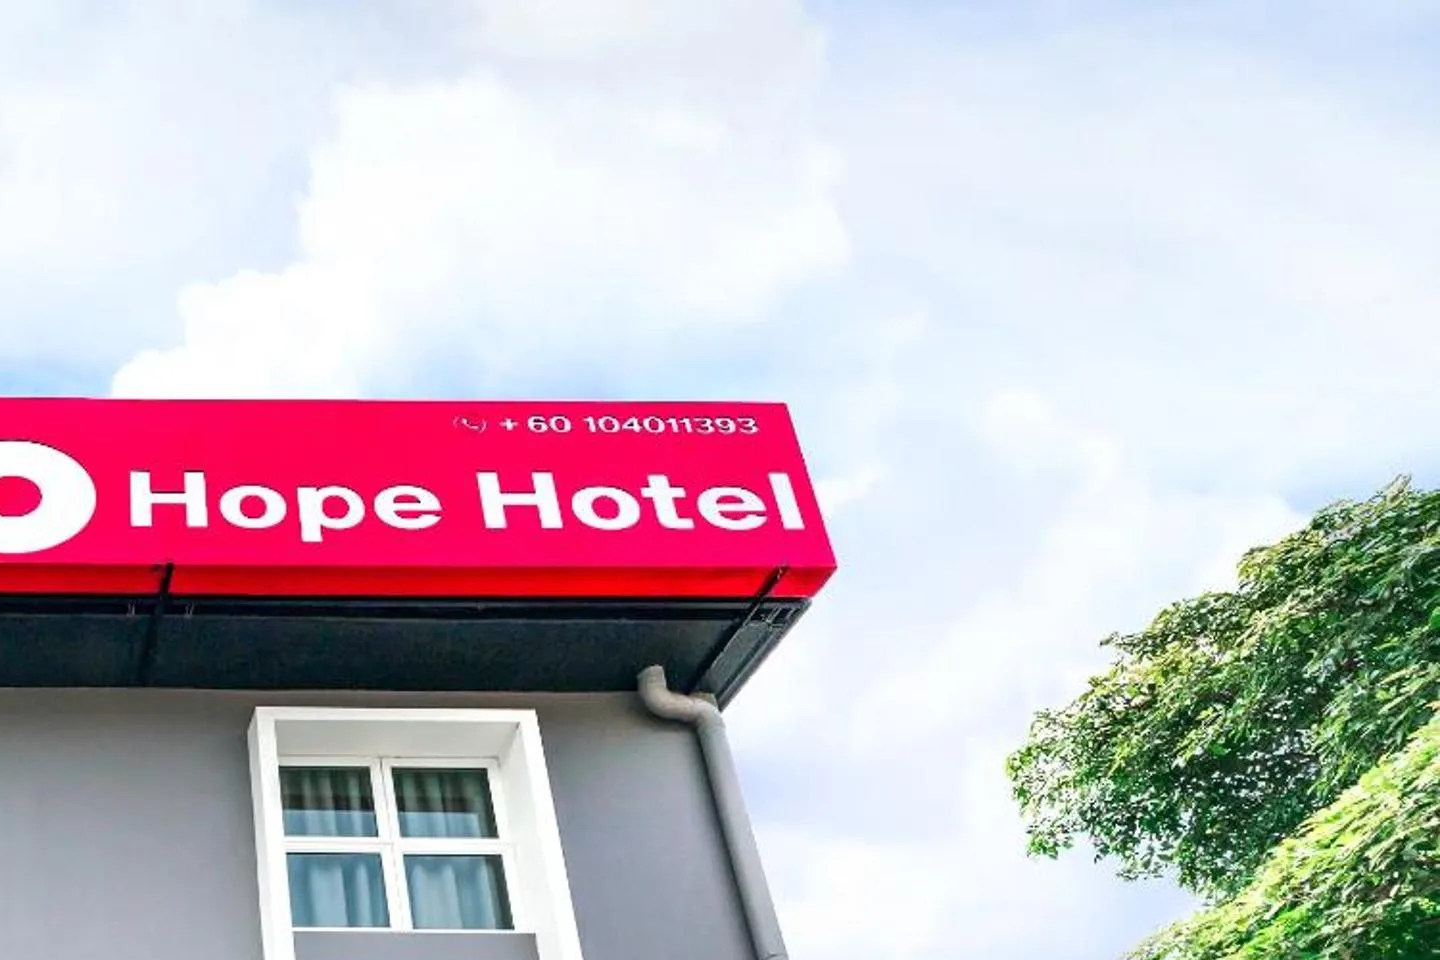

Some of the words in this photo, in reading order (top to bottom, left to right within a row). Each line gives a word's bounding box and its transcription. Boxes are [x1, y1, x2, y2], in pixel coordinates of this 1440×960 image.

[527, 415, 572, 434] 60
[583, 415, 759, 434] 104011393
[129, 471, 444, 543] Hope
[475, 471, 806, 531] Hotel
